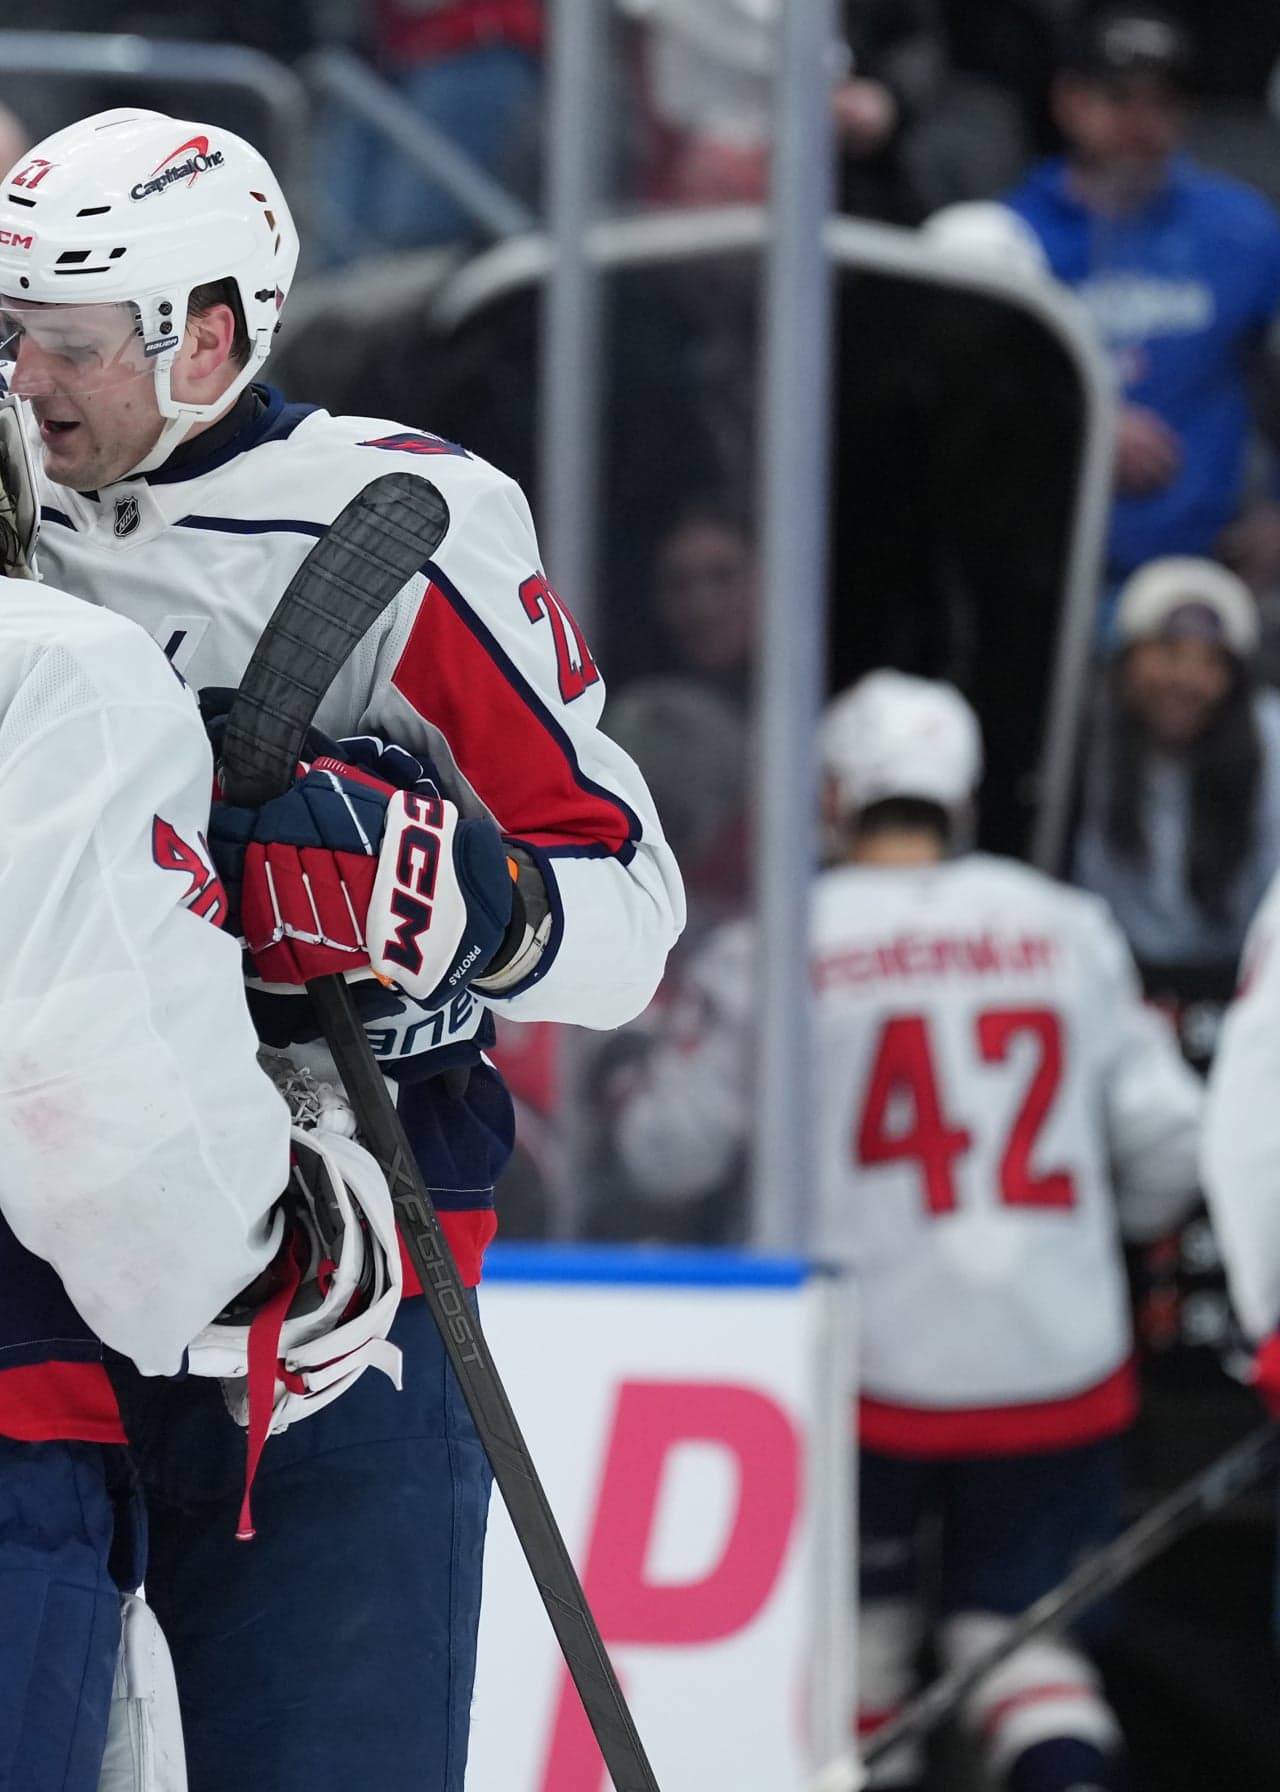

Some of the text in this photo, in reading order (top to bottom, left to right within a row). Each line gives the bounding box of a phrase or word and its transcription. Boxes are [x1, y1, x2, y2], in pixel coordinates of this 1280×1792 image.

[10, 158, 54, 190] 21
[382, 790, 446, 976] CCM
[448, 944, 483, 987] PROTAS
[853, 1009, 1079, 1218] 42
[416, 1233, 484, 1369] GHOST
